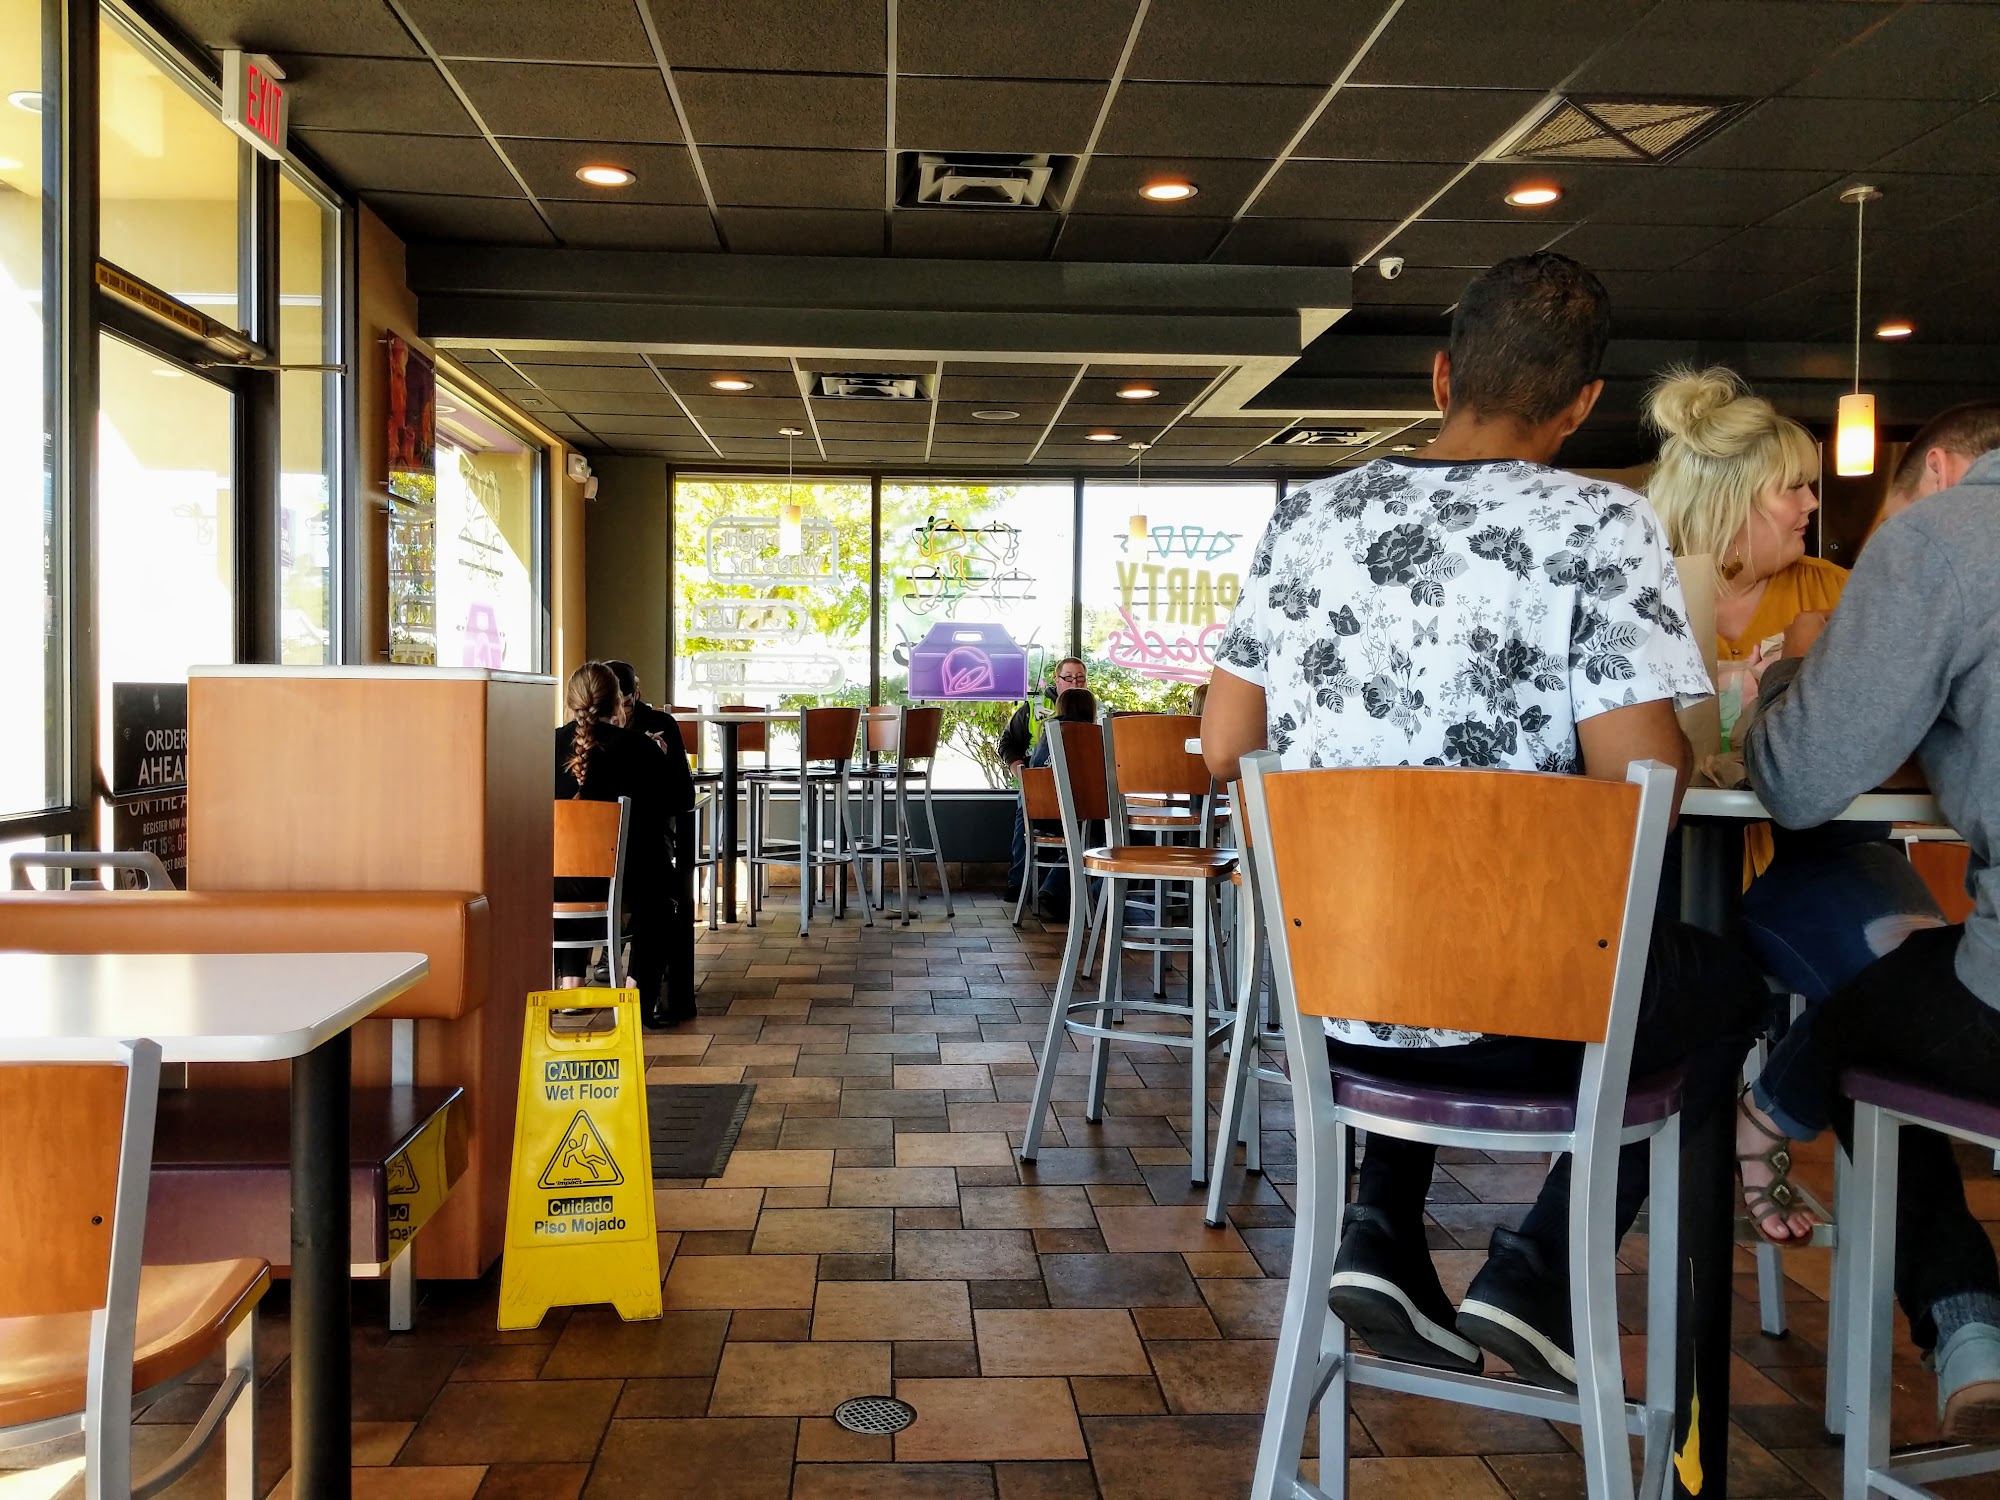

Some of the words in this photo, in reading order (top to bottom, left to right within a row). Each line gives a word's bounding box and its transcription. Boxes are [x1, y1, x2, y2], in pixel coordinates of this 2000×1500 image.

[247, 64, 283, 147] EXIT
[145, 729, 187, 752] ORDER
[143, 820, 168, 835] REGISTER
[547, 1060, 618, 1081] CAUTION
[545, 1084, 575, 1101] Wet
[580, 1083, 620, 1100] Floor
[549, 1198, 612, 1216] Cuidado
[534, 1220, 567, 1235] Piso
[571, 1216, 626, 1235] Mojado
